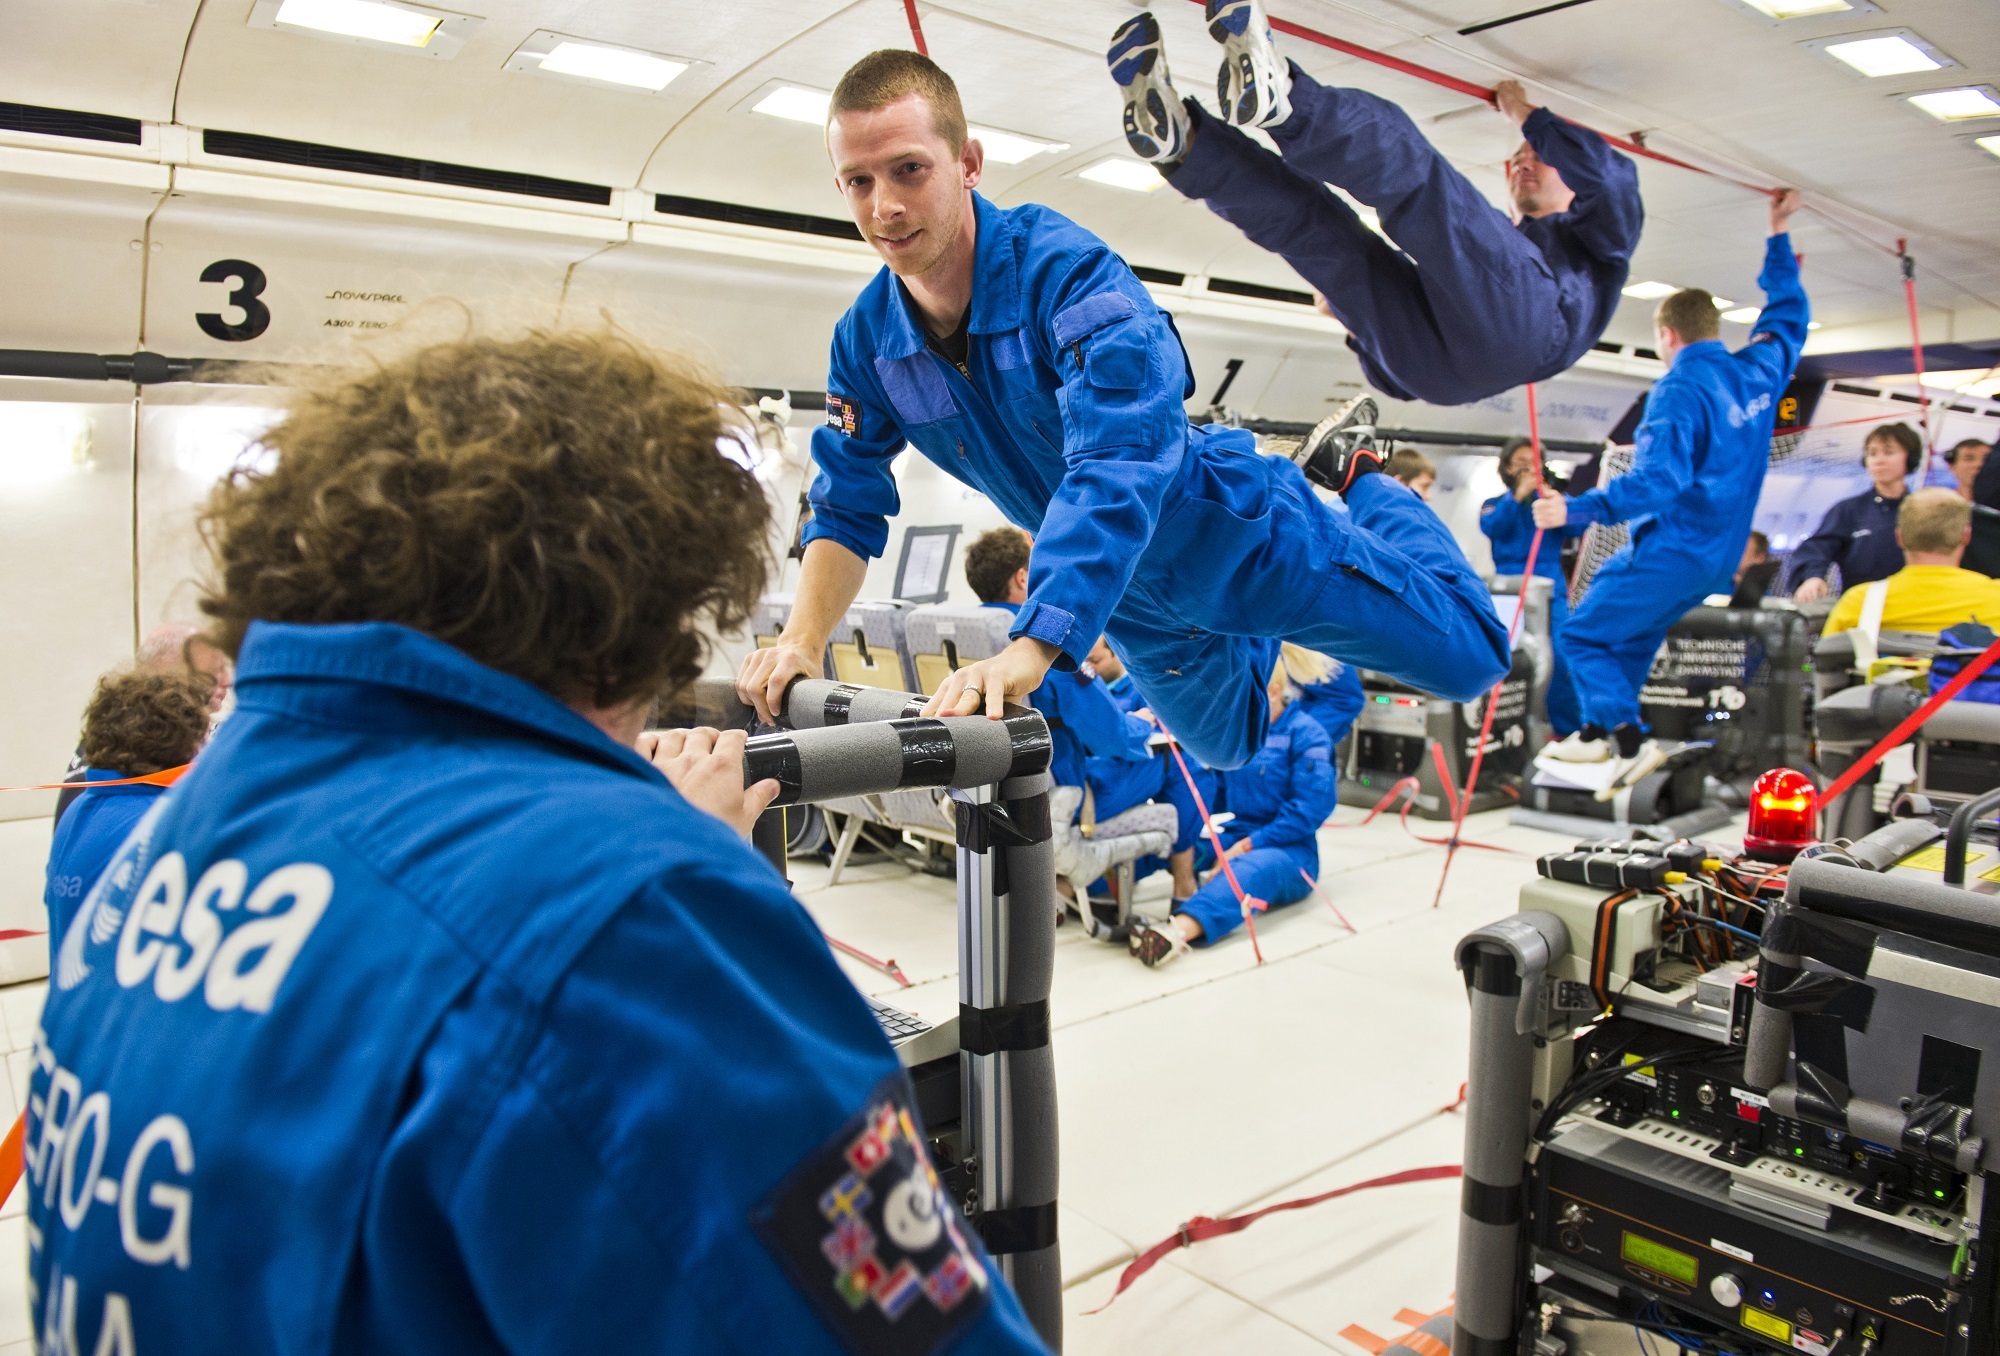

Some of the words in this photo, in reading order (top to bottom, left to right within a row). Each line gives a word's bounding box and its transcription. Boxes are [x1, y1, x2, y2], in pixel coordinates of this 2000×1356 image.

[195, 258, 271, 342] 3
[323, 318, 354, 328] A300
[1209, 358, 1245, 406] 1
[829, 413, 843, 428] esa
[1676, 638, 1746, 652] TECHNISCHE
[115, 851, 334, 1014] esa
